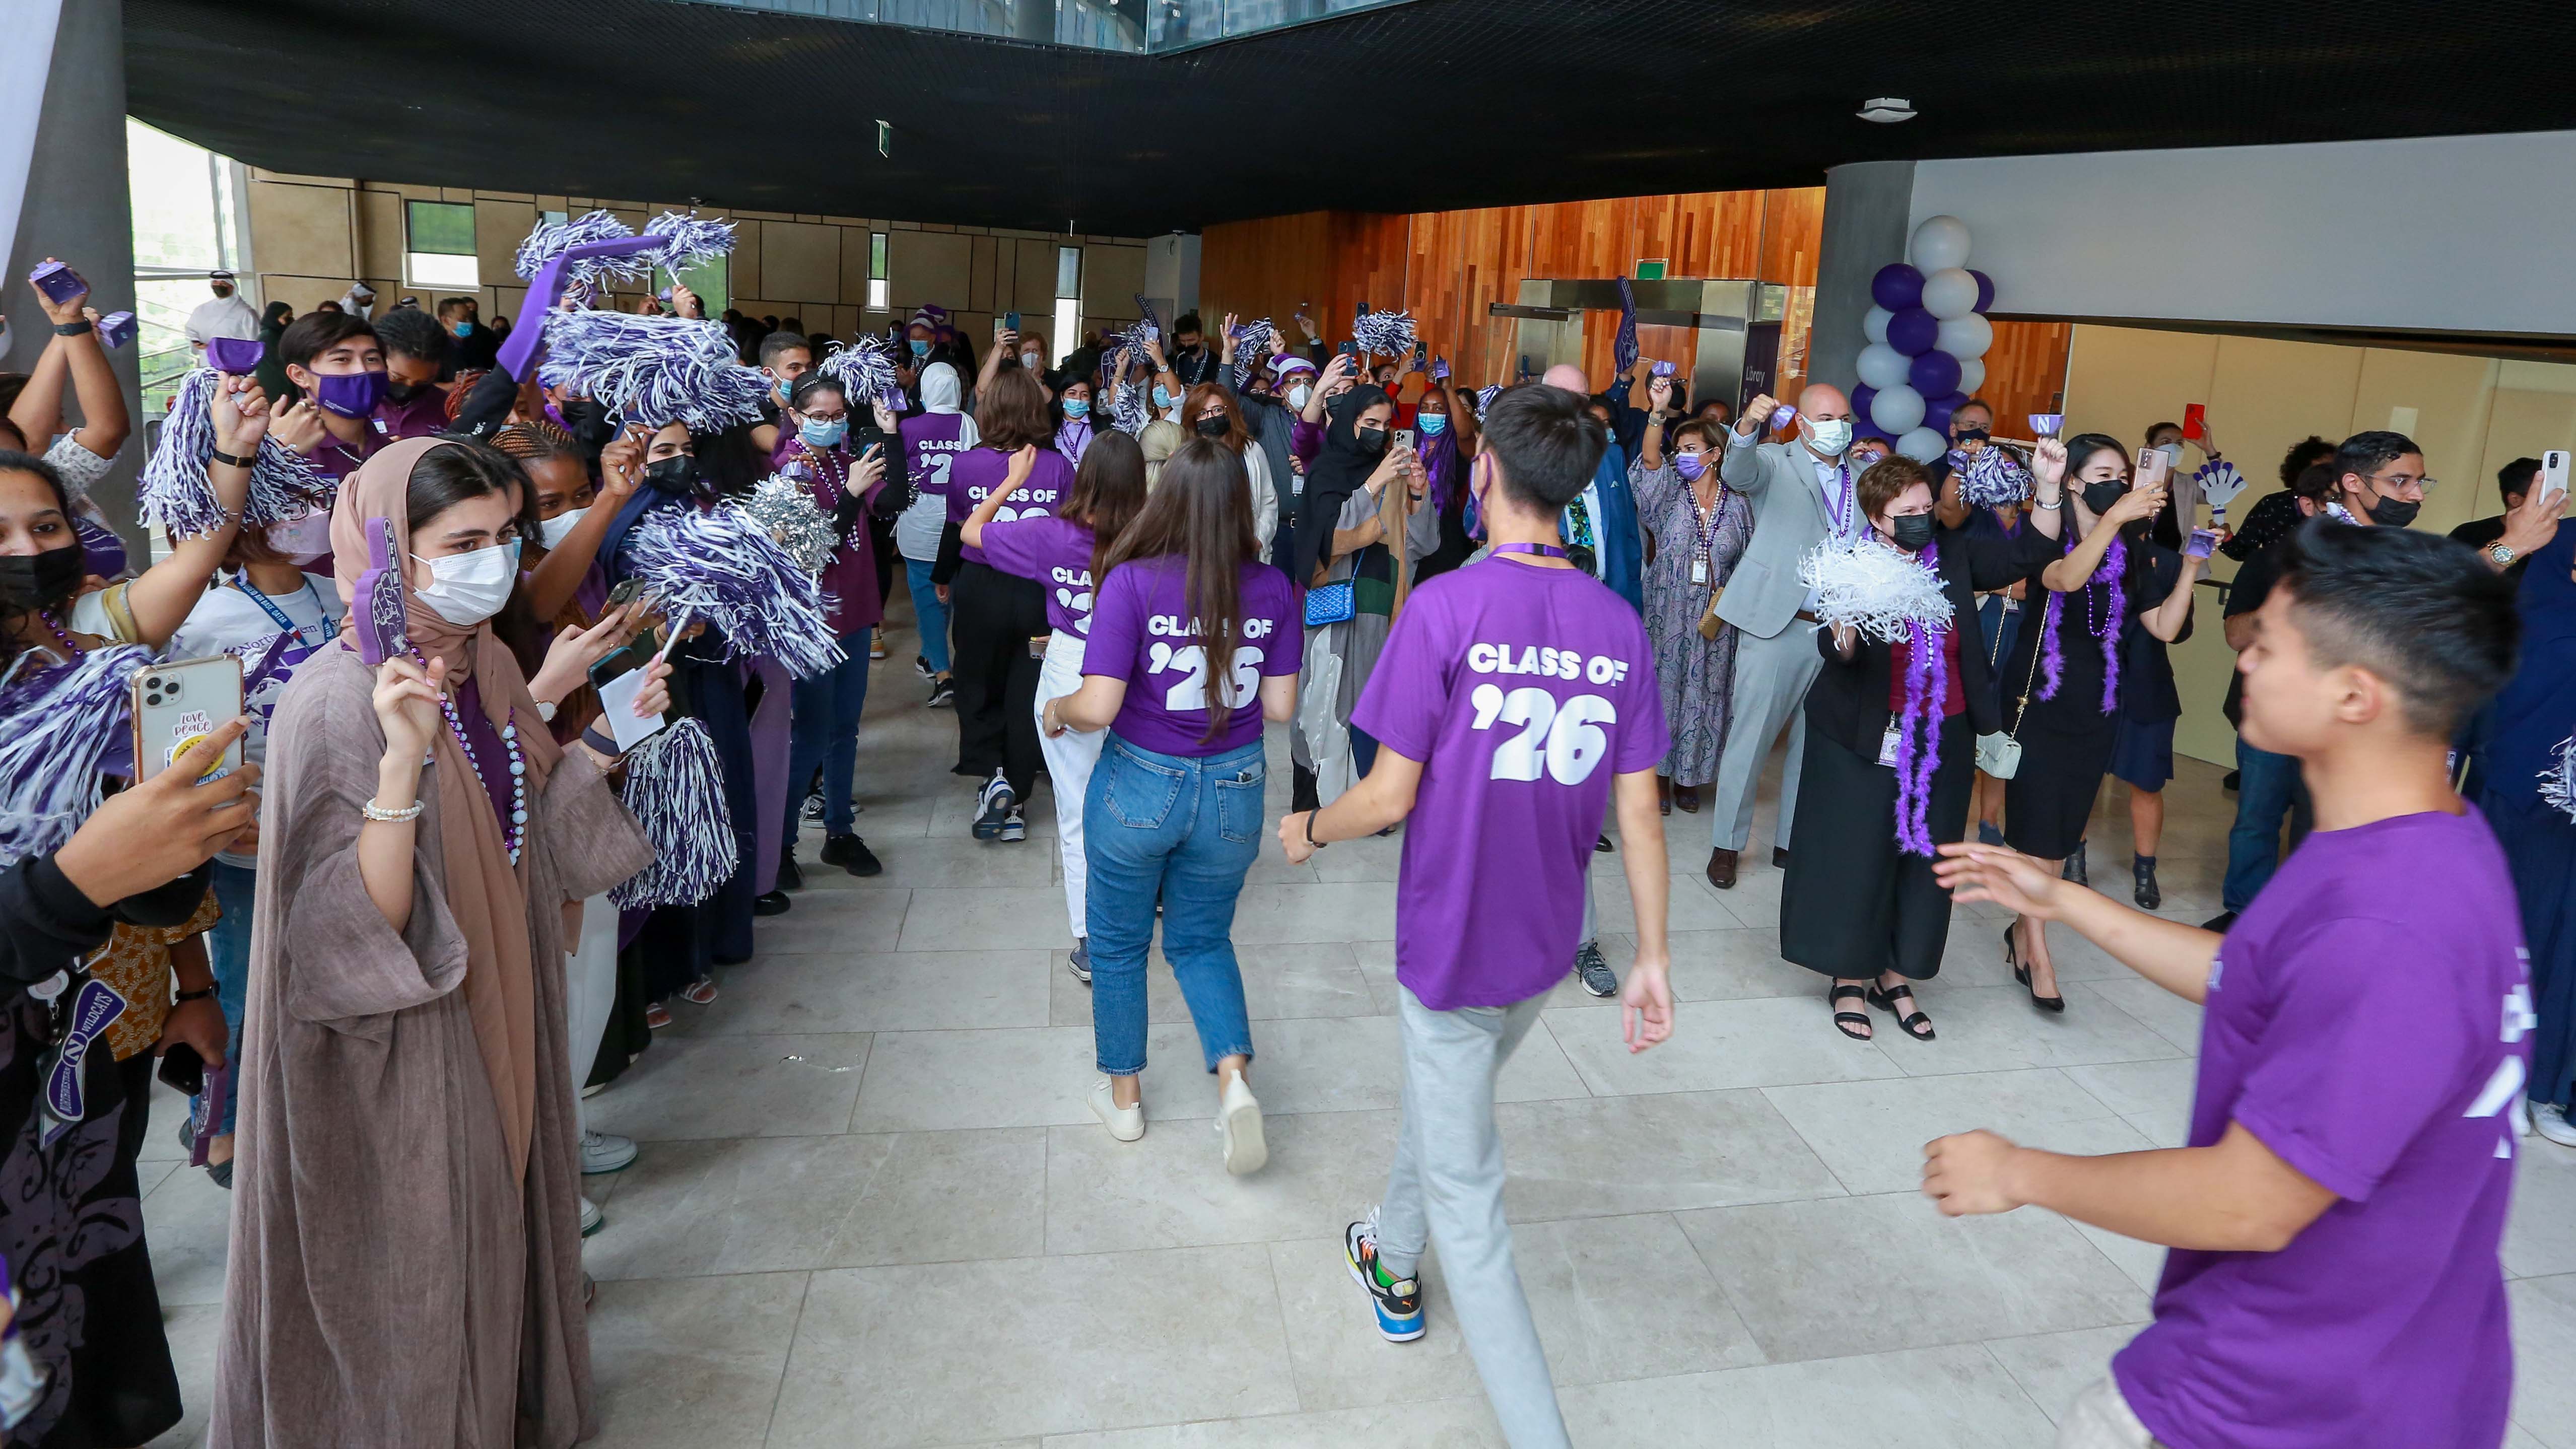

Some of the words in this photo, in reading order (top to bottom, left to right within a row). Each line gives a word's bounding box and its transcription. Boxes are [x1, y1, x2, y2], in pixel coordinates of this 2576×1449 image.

[1664, 363, 1671, 374] N
[1746, 366, 1765, 387] Library
[2038, 416, 2050, 433] N
[918, 440, 962, 450] CLASS
[786, 462, 797, 475] N
[920, 453, 953, 484] '2
[968, 486, 1030, 502] CLSS
[1033, 489, 1057, 503] OF
[1052, 567, 1093, 586] CLA
[254, 594, 264, 602] AIR
[261, 599, 275, 611] BASE
[272, 610, 288, 624] QATAR
[1243, 618, 1273, 639] OF
[1468, 643, 1582, 680] CLASS
[1586, 655, 1629, 686] OF
[1470, 683, 1617, 786] '26
[82, 992, 113, 1032] WILDCATS
[64, 1039, 85, 1061] N
[59, 1067, 72, 1114] NORTHWESTERN
